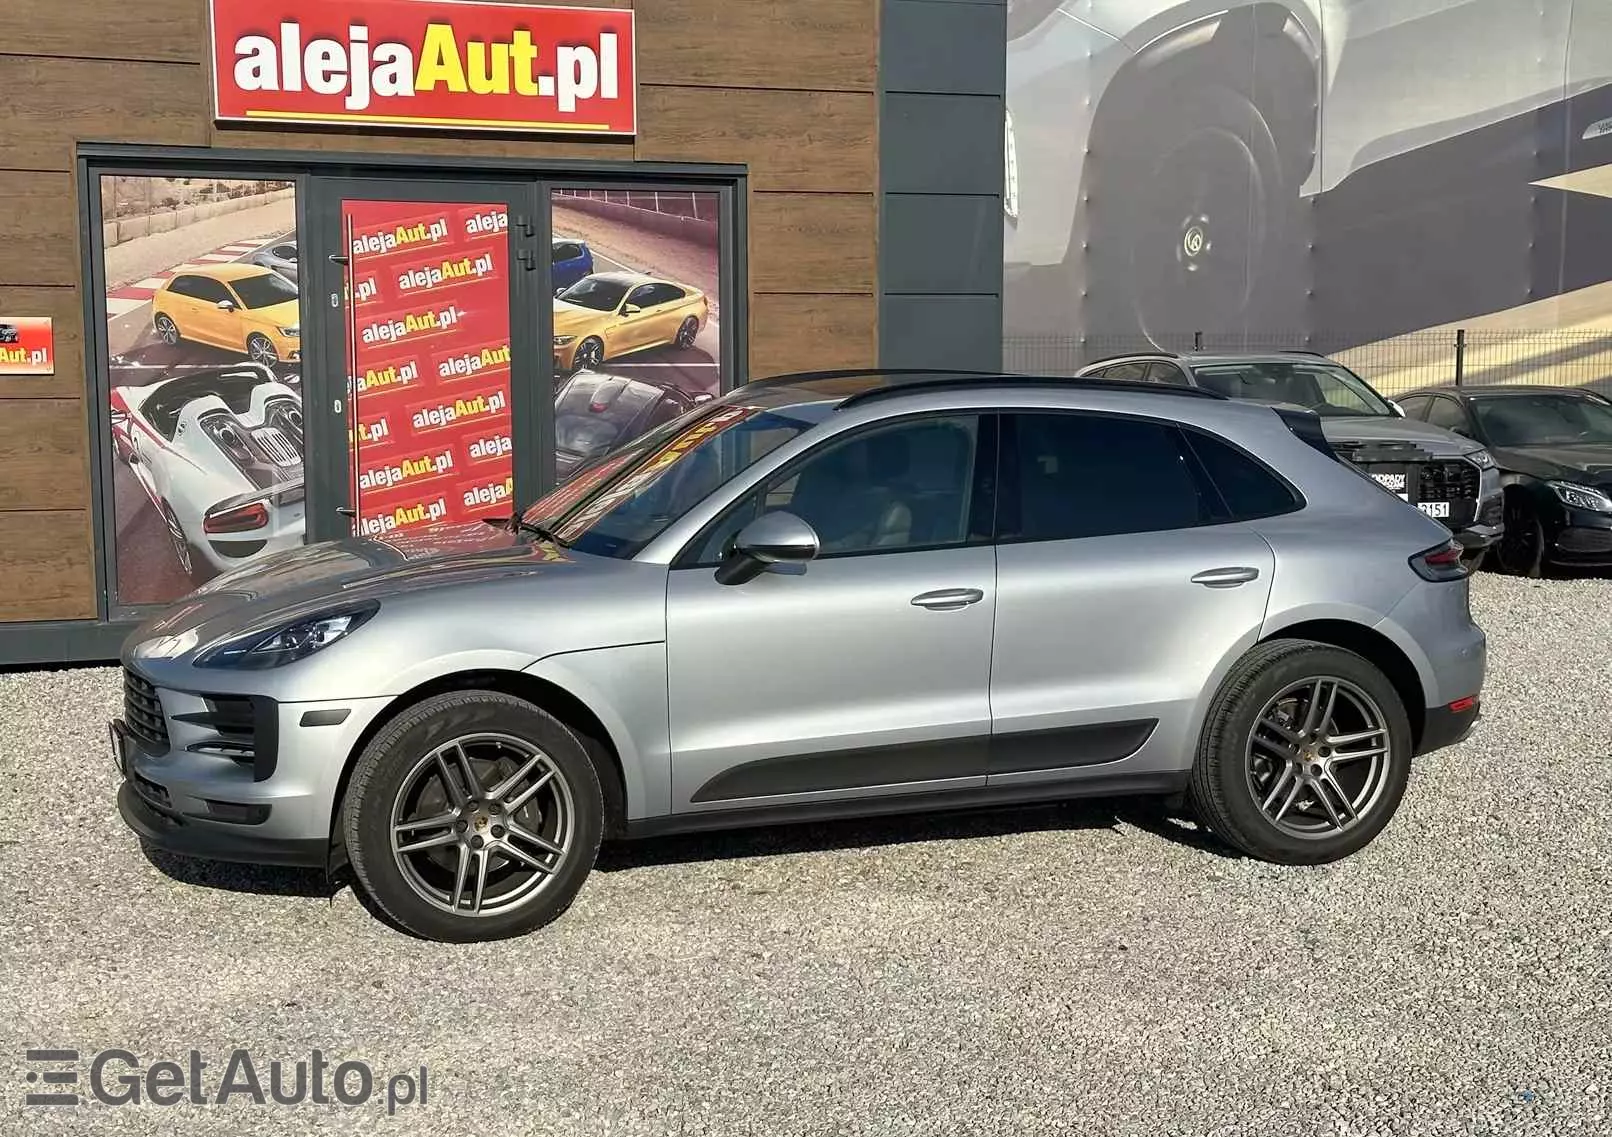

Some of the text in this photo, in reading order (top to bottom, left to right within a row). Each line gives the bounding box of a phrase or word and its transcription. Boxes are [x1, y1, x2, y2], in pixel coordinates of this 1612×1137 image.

[234, 22, 618, 112] alejaAut.pl
[353, 218, 448, 254] alejaAut.pl
[398, 253, 493, 291] alejaAut.pl
[362, 306, 457, 344] alejaAut.pl
[0, 347, 48, 366] Aut.pl
[412, 391, 506, 428] alejaAut.pl
[360, 450, 454, 489] alejaAut.pl
